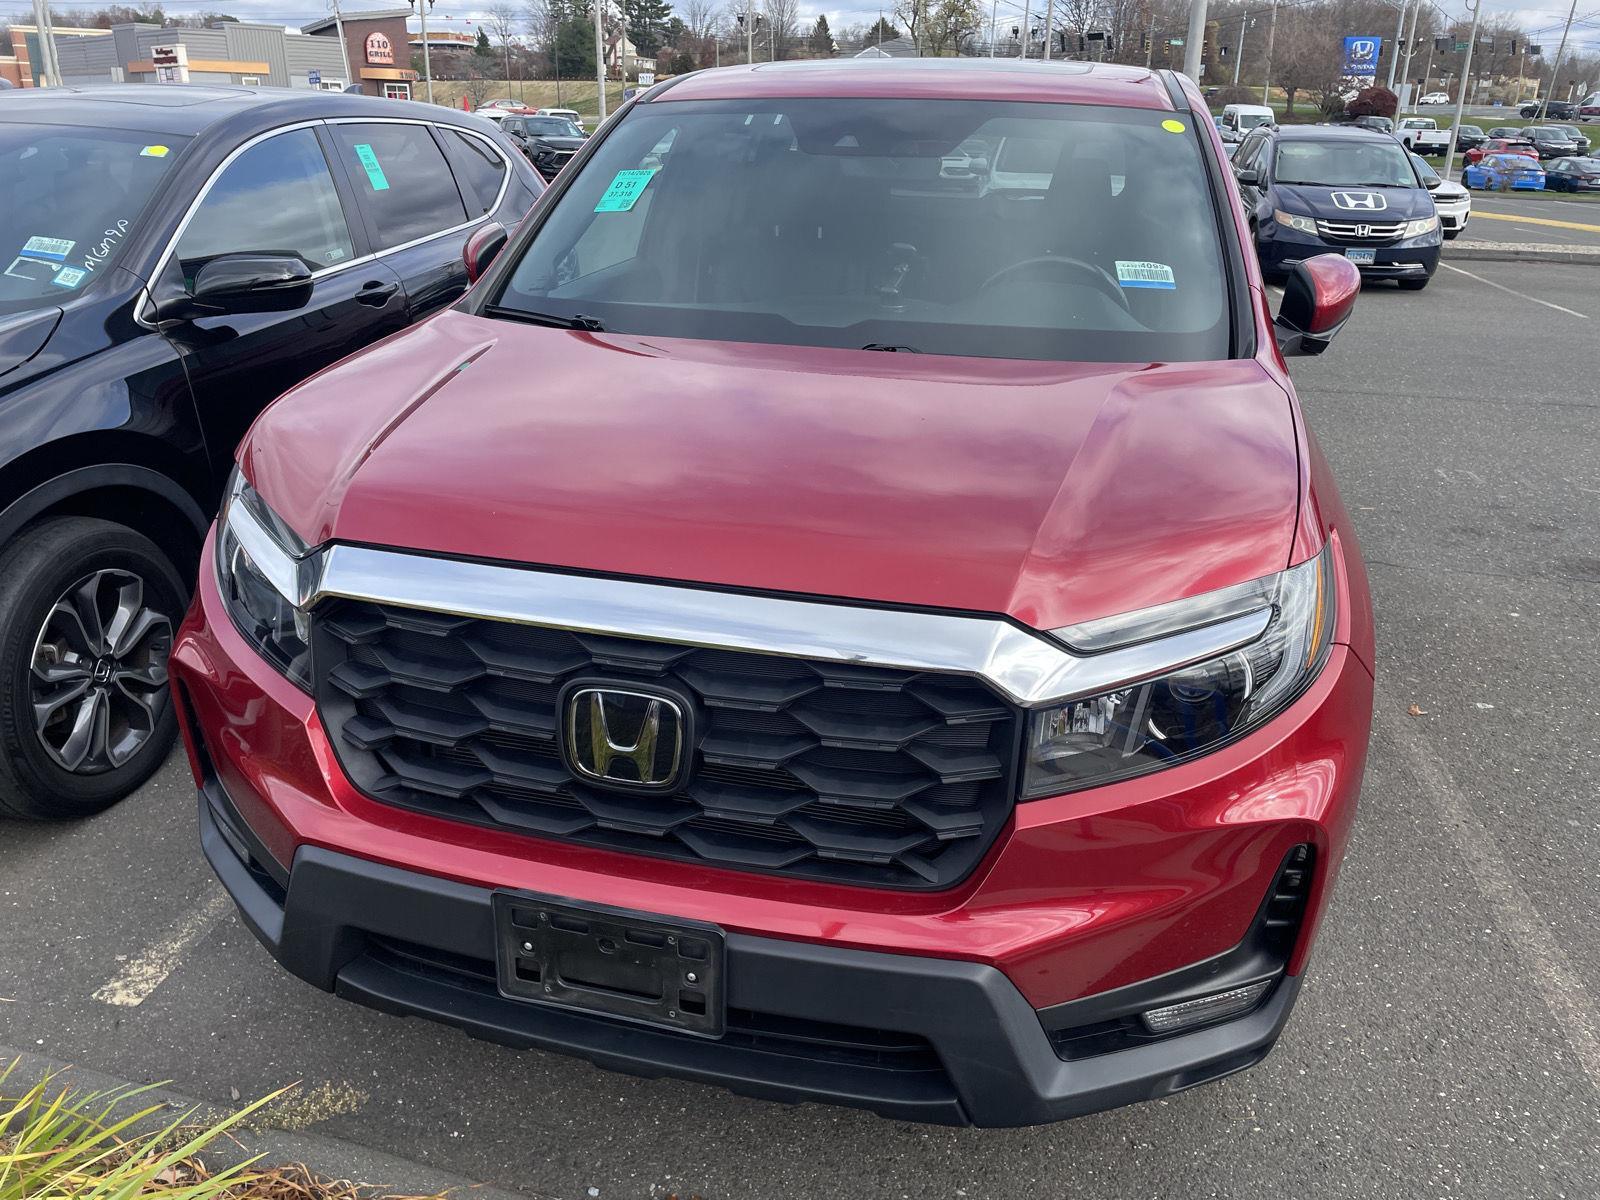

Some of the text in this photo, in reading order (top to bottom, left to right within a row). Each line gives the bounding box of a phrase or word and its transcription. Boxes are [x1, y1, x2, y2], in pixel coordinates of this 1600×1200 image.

[370, 40, 388, 49] 110
[615, 181, 638, 189] D 51
